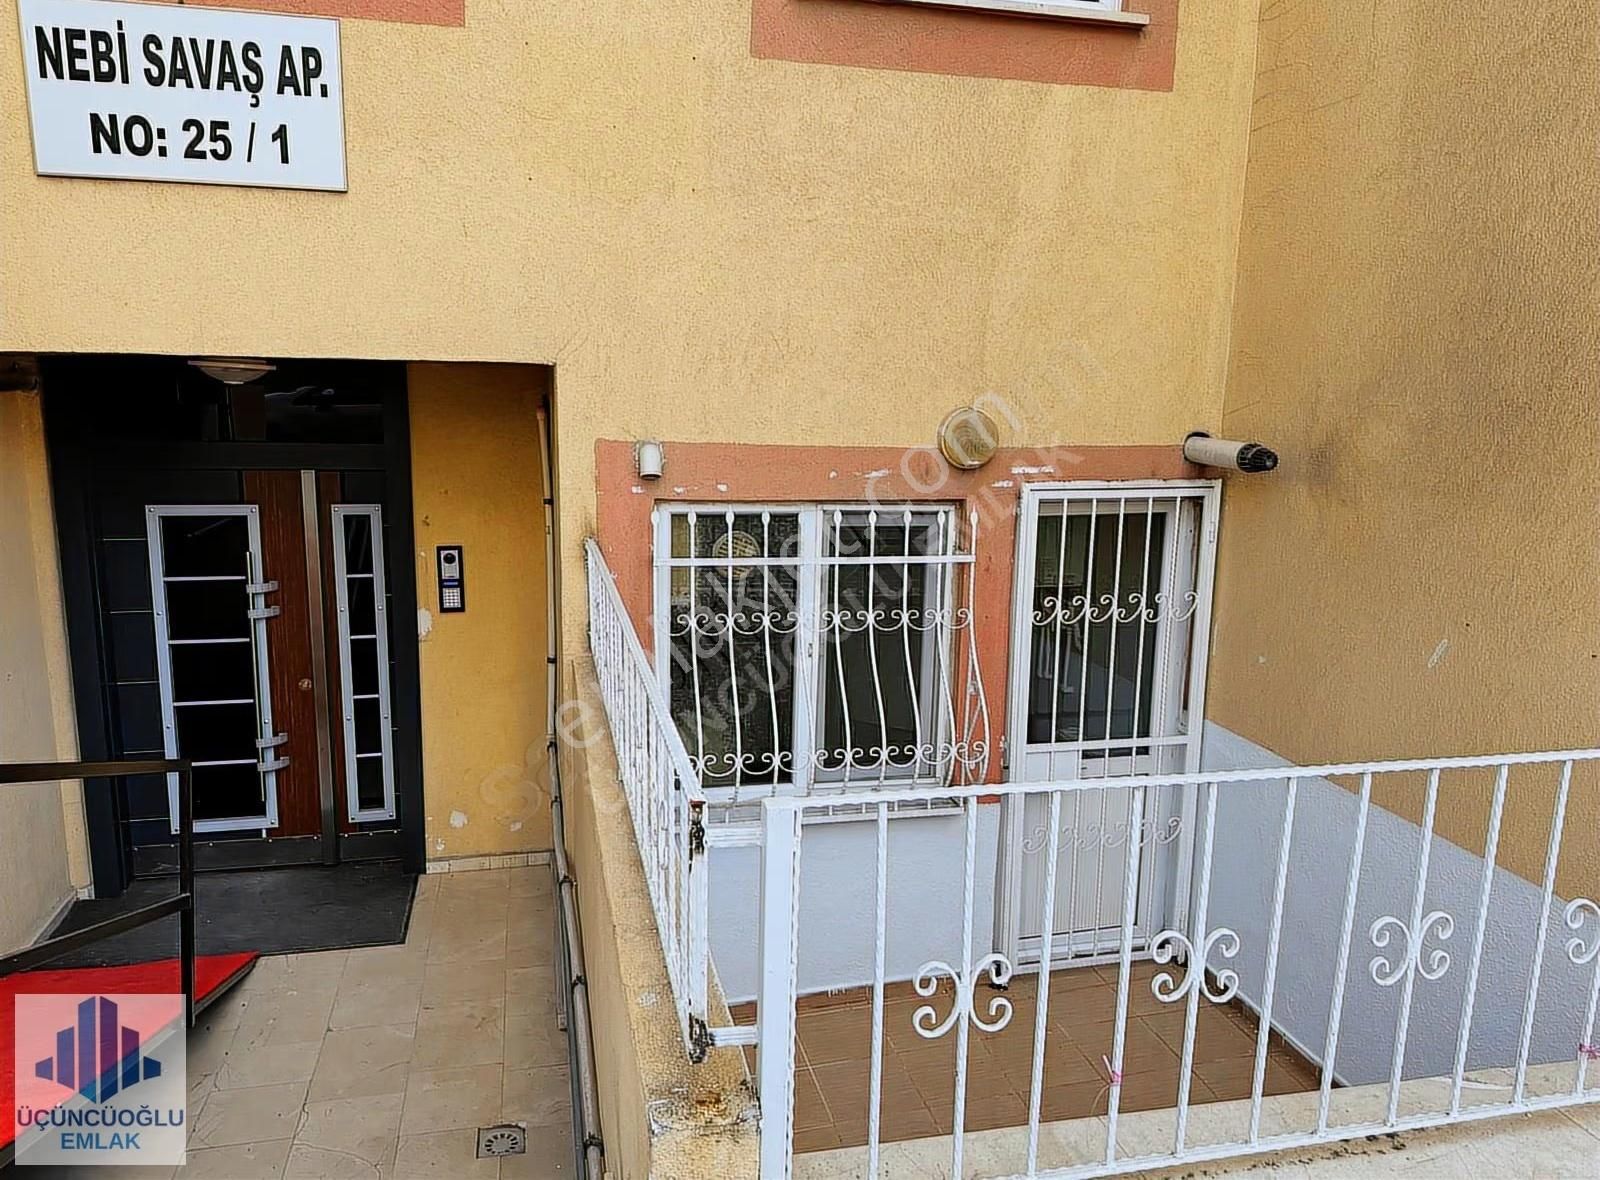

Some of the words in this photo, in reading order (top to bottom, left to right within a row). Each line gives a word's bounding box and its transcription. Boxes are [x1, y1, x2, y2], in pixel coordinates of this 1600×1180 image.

[35, 20, 130, 84] NEBİ
[142, 33, 264, 108] SAVAŞ
[276, 45, 329, 98] AP.
[89, 112, 168, 158] NO:
[182, 118, 233, 161] 25
[246, 122, 256, 162] /
[271, 123, 290, 164] 1
